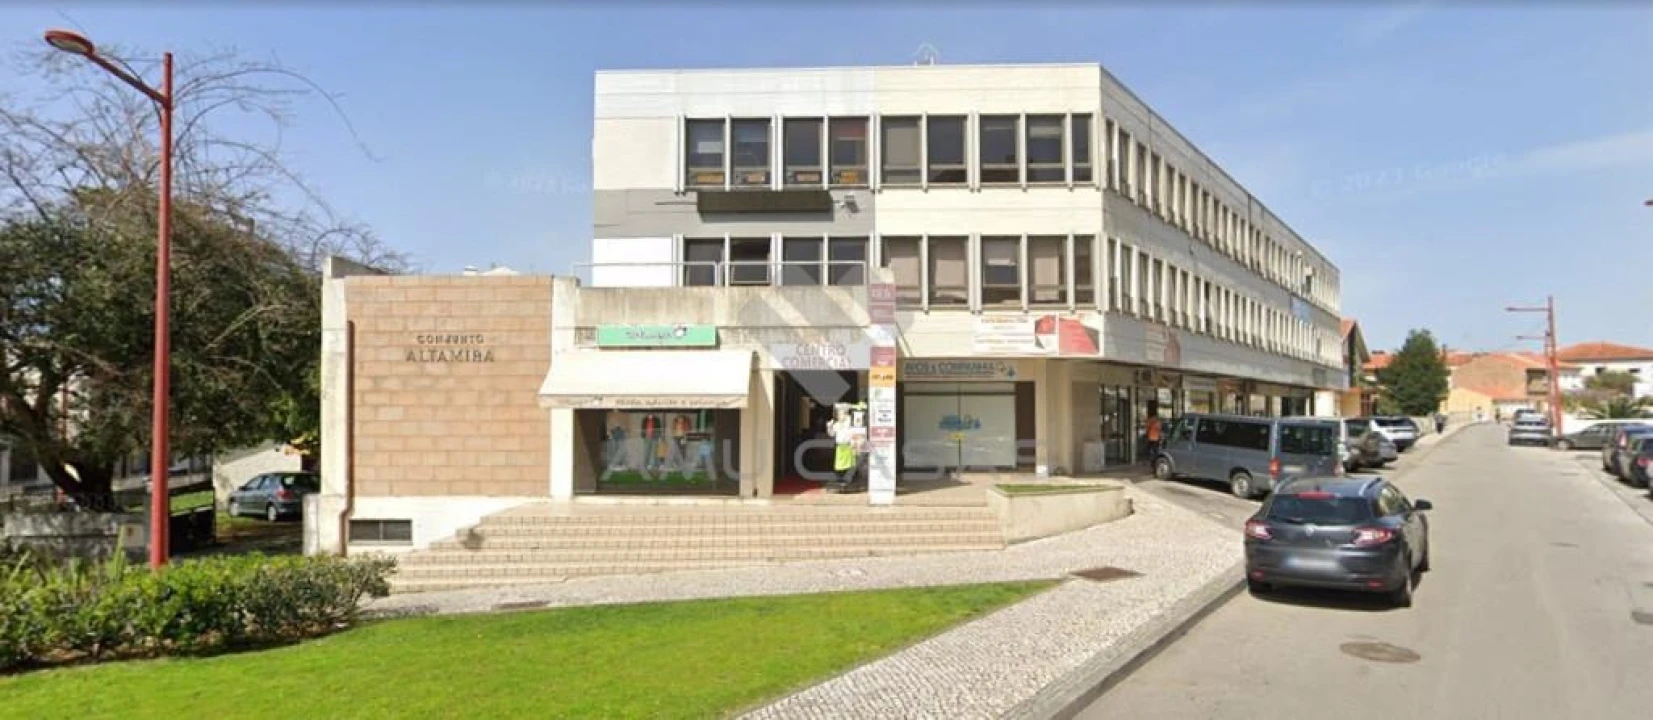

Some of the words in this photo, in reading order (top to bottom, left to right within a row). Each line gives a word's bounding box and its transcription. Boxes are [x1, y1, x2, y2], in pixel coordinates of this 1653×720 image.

[416, 334, 484, 345] CONJUNTO
[405, 349, 495, 363] ALTAMIRA
[795, 343, 847, 356] CENTRO
